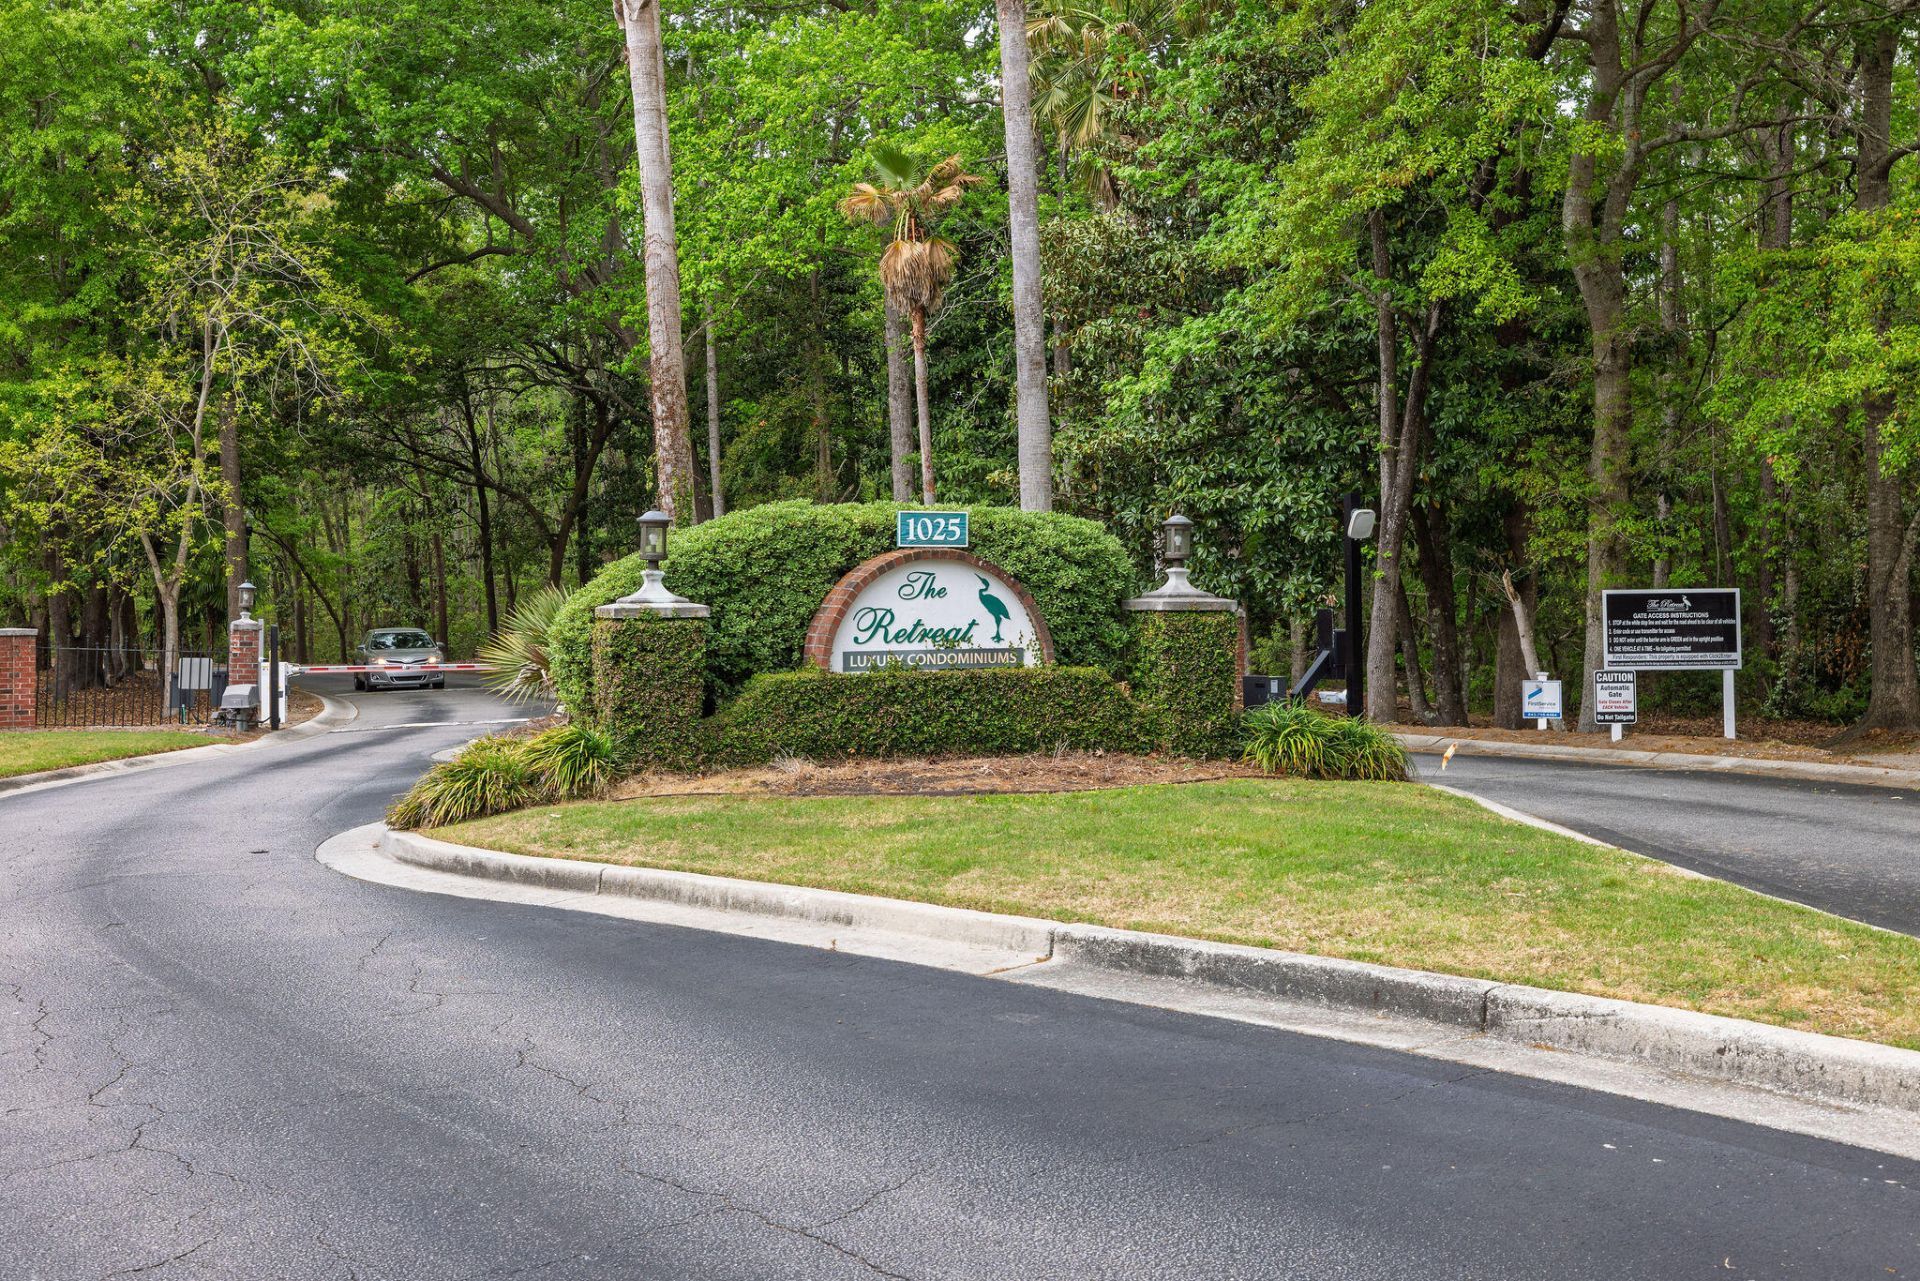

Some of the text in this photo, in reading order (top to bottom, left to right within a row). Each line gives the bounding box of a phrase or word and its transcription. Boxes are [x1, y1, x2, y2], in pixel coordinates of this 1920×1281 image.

[906, 518, 962, 541] 1025
[898, 571, 948, 600] The
[1646, 599, 1684, 608] The Retreat
[853, 606, 980, 645] Retreat
[907, 652, 1017, 666] CONDOMINIUMS
[1596, 673, 1633, 682] CAUTION
